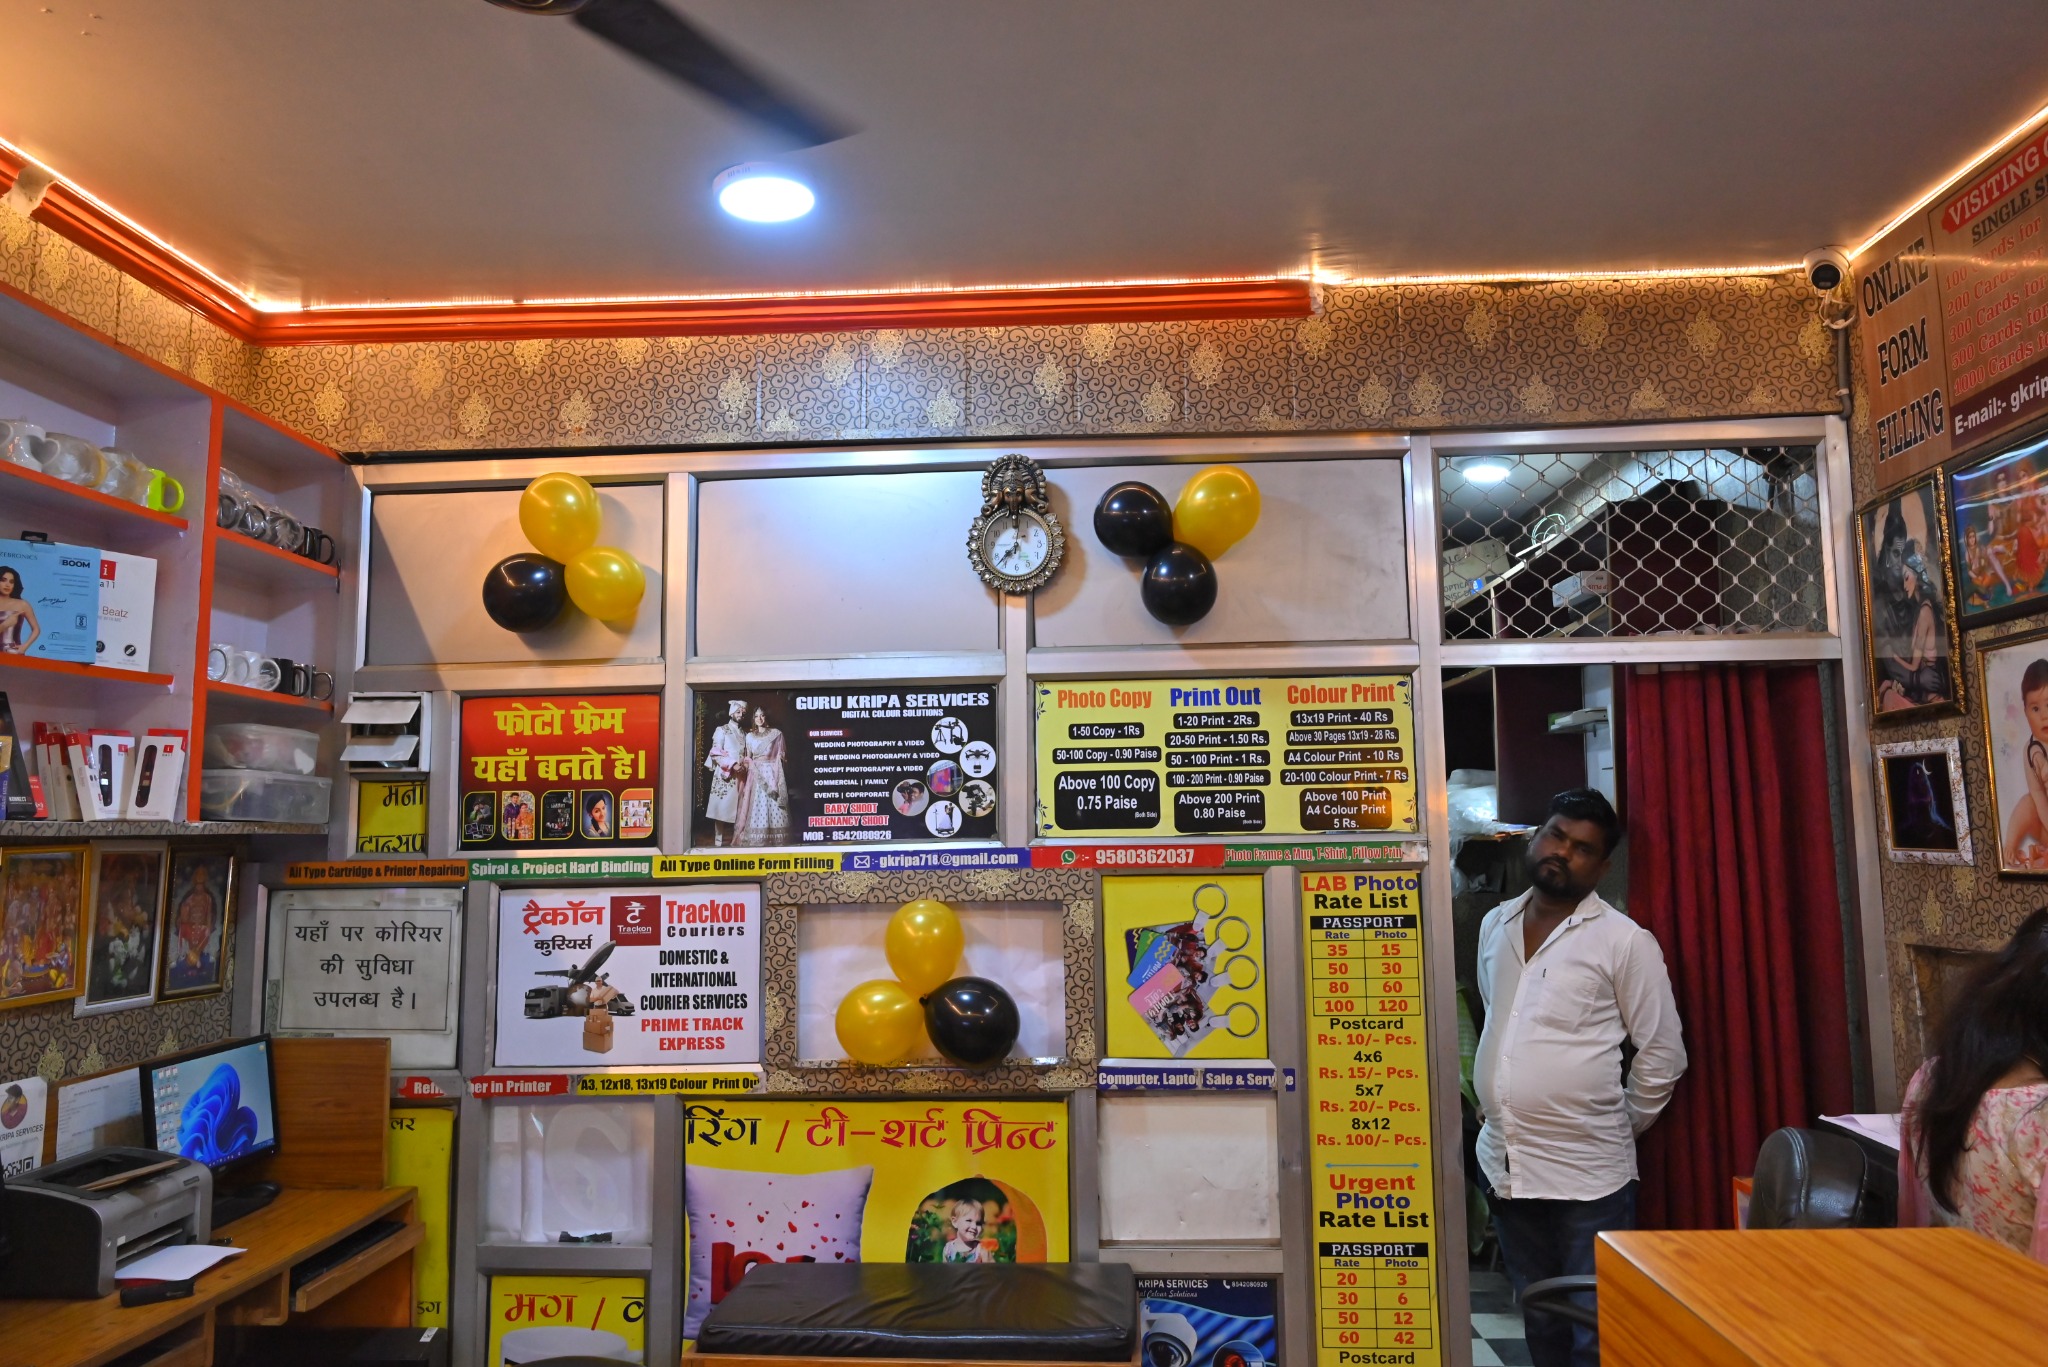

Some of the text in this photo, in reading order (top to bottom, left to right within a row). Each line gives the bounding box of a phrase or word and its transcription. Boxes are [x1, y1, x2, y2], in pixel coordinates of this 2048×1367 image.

[1948, 146, 2040, 226] VISITING
[1972, 190, 2031, 244] SINGLE
[1863, 237, 1929, 317] ONLINE
[1877, 317, 1928, 386] FORM
[1952, 319, 2022, 371] 500 Cards
[1954, 342, 2033, 396] 1000 Cards
[1876, 388, 1944, 463] FILLING
[62, 560, 90, 569] BOOM
[103, 606, 128, 618] Beatz
[796, 692, 989, 710] GURU KRIPA SERVICES
[1057, 688, 1152, 709] Photo Copy
[1170, 686, 1261, 706] Print Out
[1287, 684, 1395, 705] Colour Print
[494, 701, 626, 736] फोटो फ्रेम
[842, 709, 943, 719] DIGITAL COLOUR SOLUTIONS
[1178, 715, 1255, 726] 1-20 Print 2Rs.
[1073, 725, 1140, 738] 1-50 Copy 1Rs
[847, 740, 896, 748] PHOTOGRAPHY
[1288, 750, 1399, 762] A4 Colour Print 10 Rs
[471, 748, 529, 783] यहाँ
[535, 747, 605, 782] बनते
[1058, 775, 1155, 792] Above 100 Copy
[1077, 795, 1137, 810] 0.75 Paise
[1305, 790, 1386, 801] Above 100 Print
[824, 803, 877, 814] BABY SHOOT
[808, 815, 889, 827] PREGNANCY SHOOT
[803, 831, 823, 841] MOB
[1095, 848, 1195, 865] 9580362037
[1225, 849, 1251, 861] Photo
[1254, 849, 1282, 861] Frame
[1353, 846, 1381, 859] Pillow
[472, 860, 649, 877] Spiral & Project Hard Binding
[660, 856, 834, 872] All Type Online Form Filling
[289, 865, 465, 879] All Type Cartridge Printer Repairing
[1304, 875, 1418, 891] LAB Photo
[1314, 894, 1408, 909] Rate List
[522, 899, 606, 936] ट्रैकॉन
[666, 900, 745, 923] Trackon
[617, 925, 652, 933] Trackon
[1323, 916, 1404, 928] PASSPORT
[294, 920, 443, 942] यहाँ पर कोरियर
[667, 925, 745, 937] Couriers
[1325, 930, 1407, 939] Rate Photo
[534, 935, 593, 957] कुरियर्स
[1327, 944, 1400, 956] 35 15
[659, 949, 729, 966] DOMESTIC &
[320, 953, 414, 980] की सुविधा
[650, 972, 737, 988] INTERNATIONAL
[313, 992, 380, 1007] उपलब्ध
[640, 994, 747, 1010] COURIER SERVICES
[1325, 1000, 1408, 1012] 100 120
[641, 1017, 743, 1032] PRIME TRACK
[1330, 1018, 1404, 1030] Postcard
[659, 1036, 725, 1051] EXPRESS
[1318, 1033, 1417, 1046] Rs. 10/- Pcs.
[1354, 1051, 1382, 1063] 4x6
[491, 1080, 551, 1093] in Printer
[581, 1077, 740, 1091] A3, 12x18, 13x19 Colour Print
[1099, 1073, 1231, 1086] Computer, Sale
[1355, 1084, 1383, 1096] 5x7
[16, 1124, 43, 1137] SERVICES
[1352, 1118, 1390, 1130] 8x12
[1329, 1174, 1415, 1194] Urgent
[1337, 1193, 1410, 1209] Photo
[1319, 1211, 1429, 1228] Rate List
[1332, 1244, 1415, 1256] PASSPORT
[1139, 1280, 1164, 1288] KRIPA
[1167, 1280, 1208, 1288] SERVICES
[1337, 1273, 1407, 1285] 20 3
[1169, 1290, 1198, 1298] Solutions
[504, 1294, 578, 1322] मग
[1339, 1332, 1414, 1344] 60 42
[1339, 1352, 1415, 1364] Postcard
